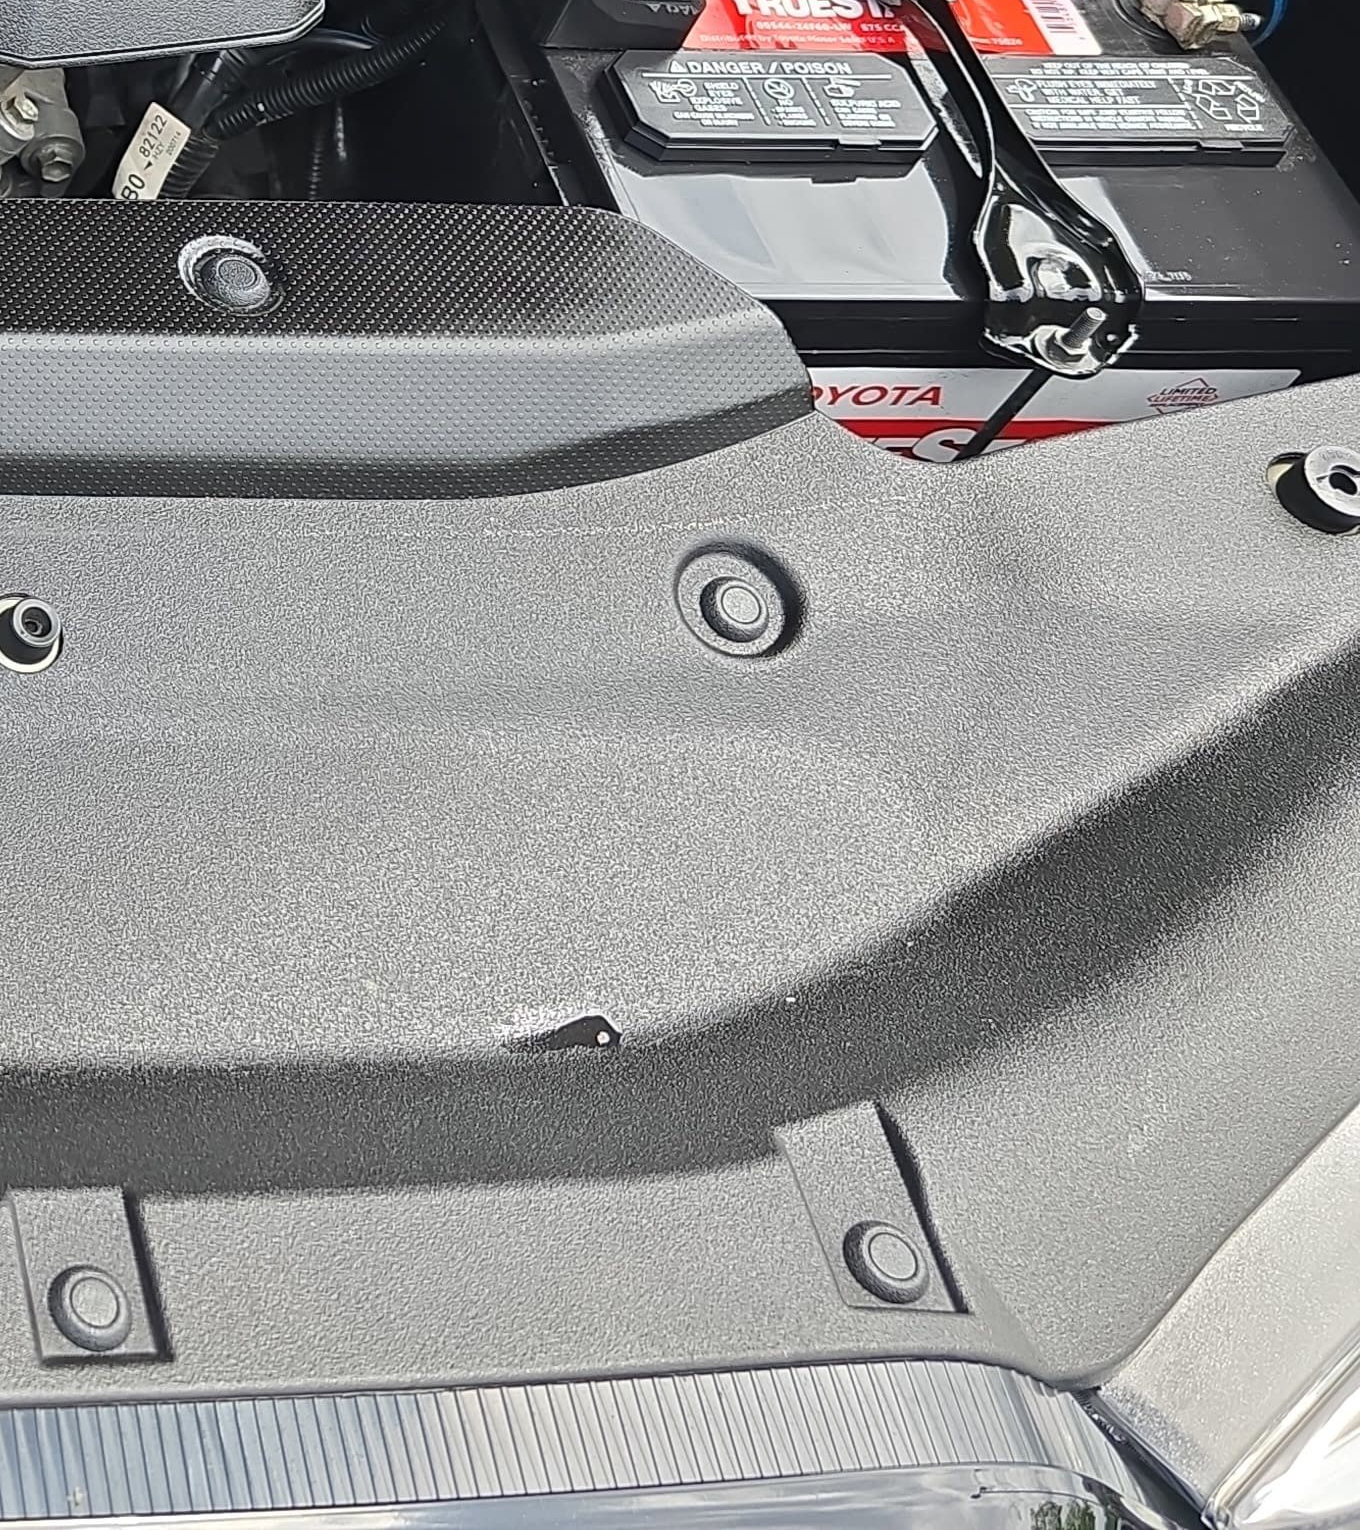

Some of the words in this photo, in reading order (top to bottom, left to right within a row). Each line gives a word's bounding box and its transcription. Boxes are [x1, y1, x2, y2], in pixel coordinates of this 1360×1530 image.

[686, 61, 766, 74] DANGER
[767, 62, 779, 74] /
[779, 62, 852, 75] POISON
[1041, 88, 1068, 97] WITH
[1046, 96, 1089, 104] MEDICAL
[1089, 96, 1117, 105] HELP
[1116, 96, 1141, 105] FAST
[138, 114, 168, 158] 82122
[1159, 387, 1217, 396] LIMITED
[1153, 395, 1214, 403] LIFETIME
